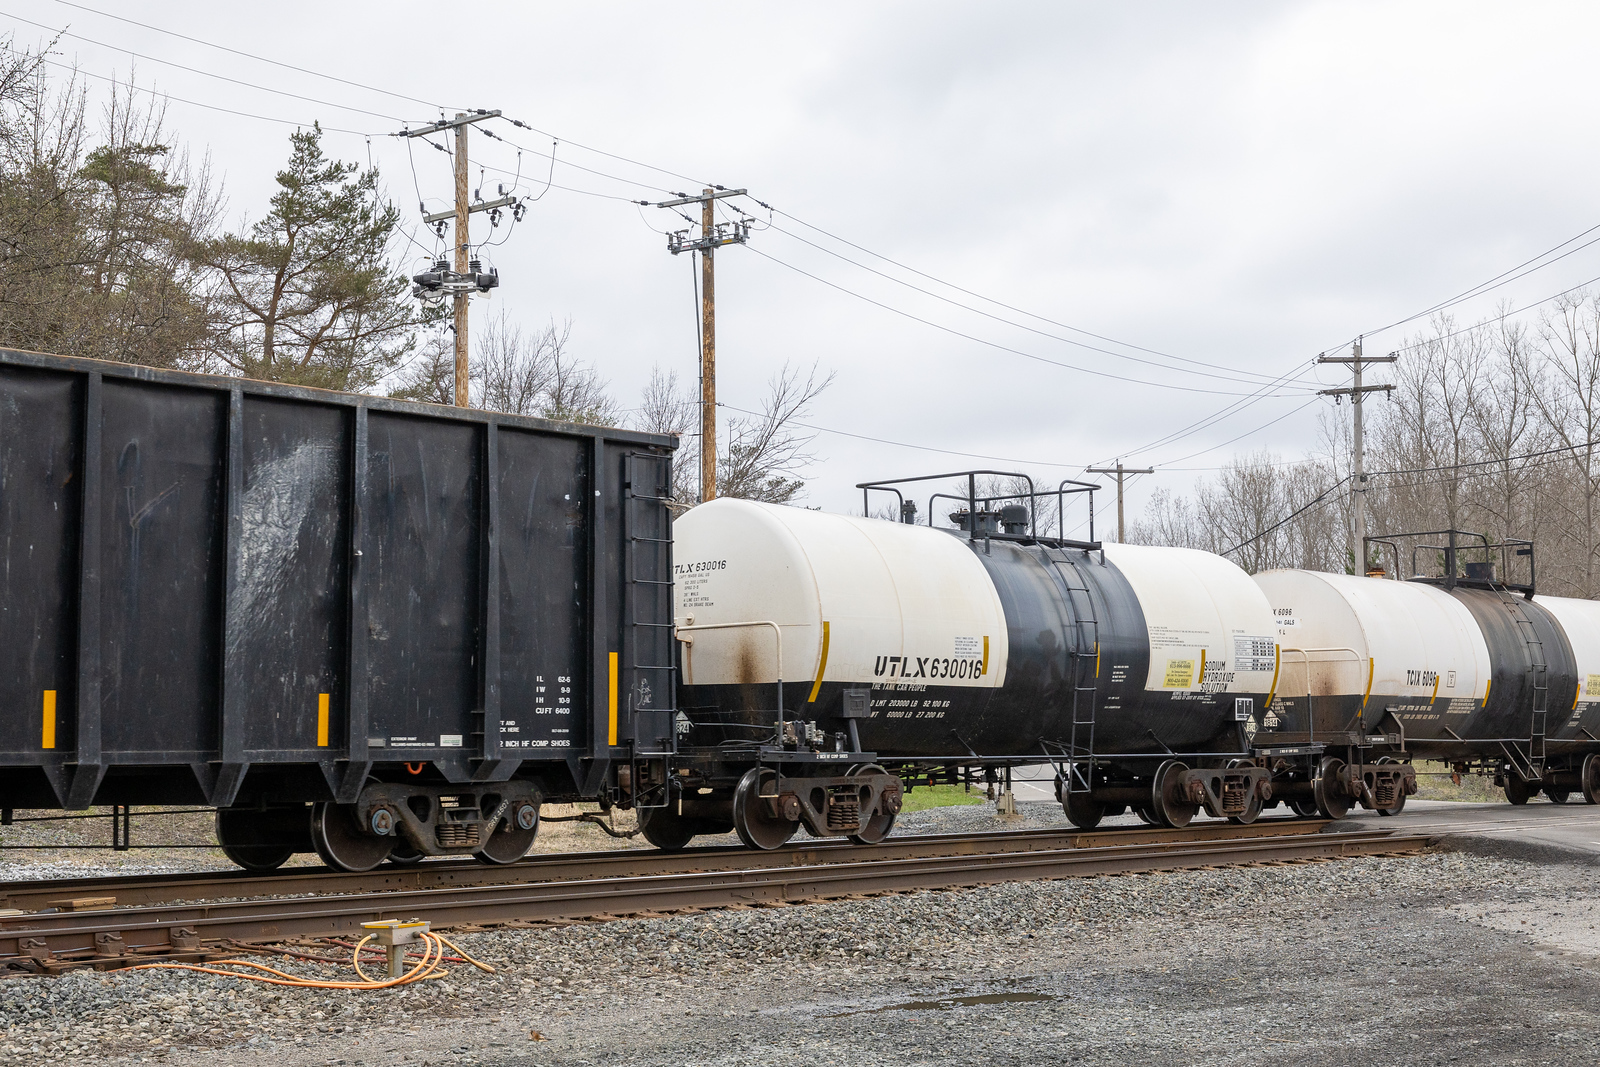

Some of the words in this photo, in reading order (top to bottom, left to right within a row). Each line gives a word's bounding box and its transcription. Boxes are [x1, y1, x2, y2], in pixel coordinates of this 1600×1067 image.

[673, 563, 694, 574] TLX
[696, 560, 727, 572] 630016
[1278, 608, 1292, 616] 6096
[874, 655, 930, 678] UTLX
[930, 658, 983, 679] 630016
[1204, 661, 1226, 671] SODIUM
[1203, 672, 1235, 682] HYDROXIDE
[1406, 669, 1421, 686] TCIX
[1422, 671, 1437, 686] 6096
[882, 683, 895, 691] TANK
[908, 684, 927, 692] PEOPLE
[1200, 683, 1229, 692] SOLUTION
[676, 722, 689, 733] 824
